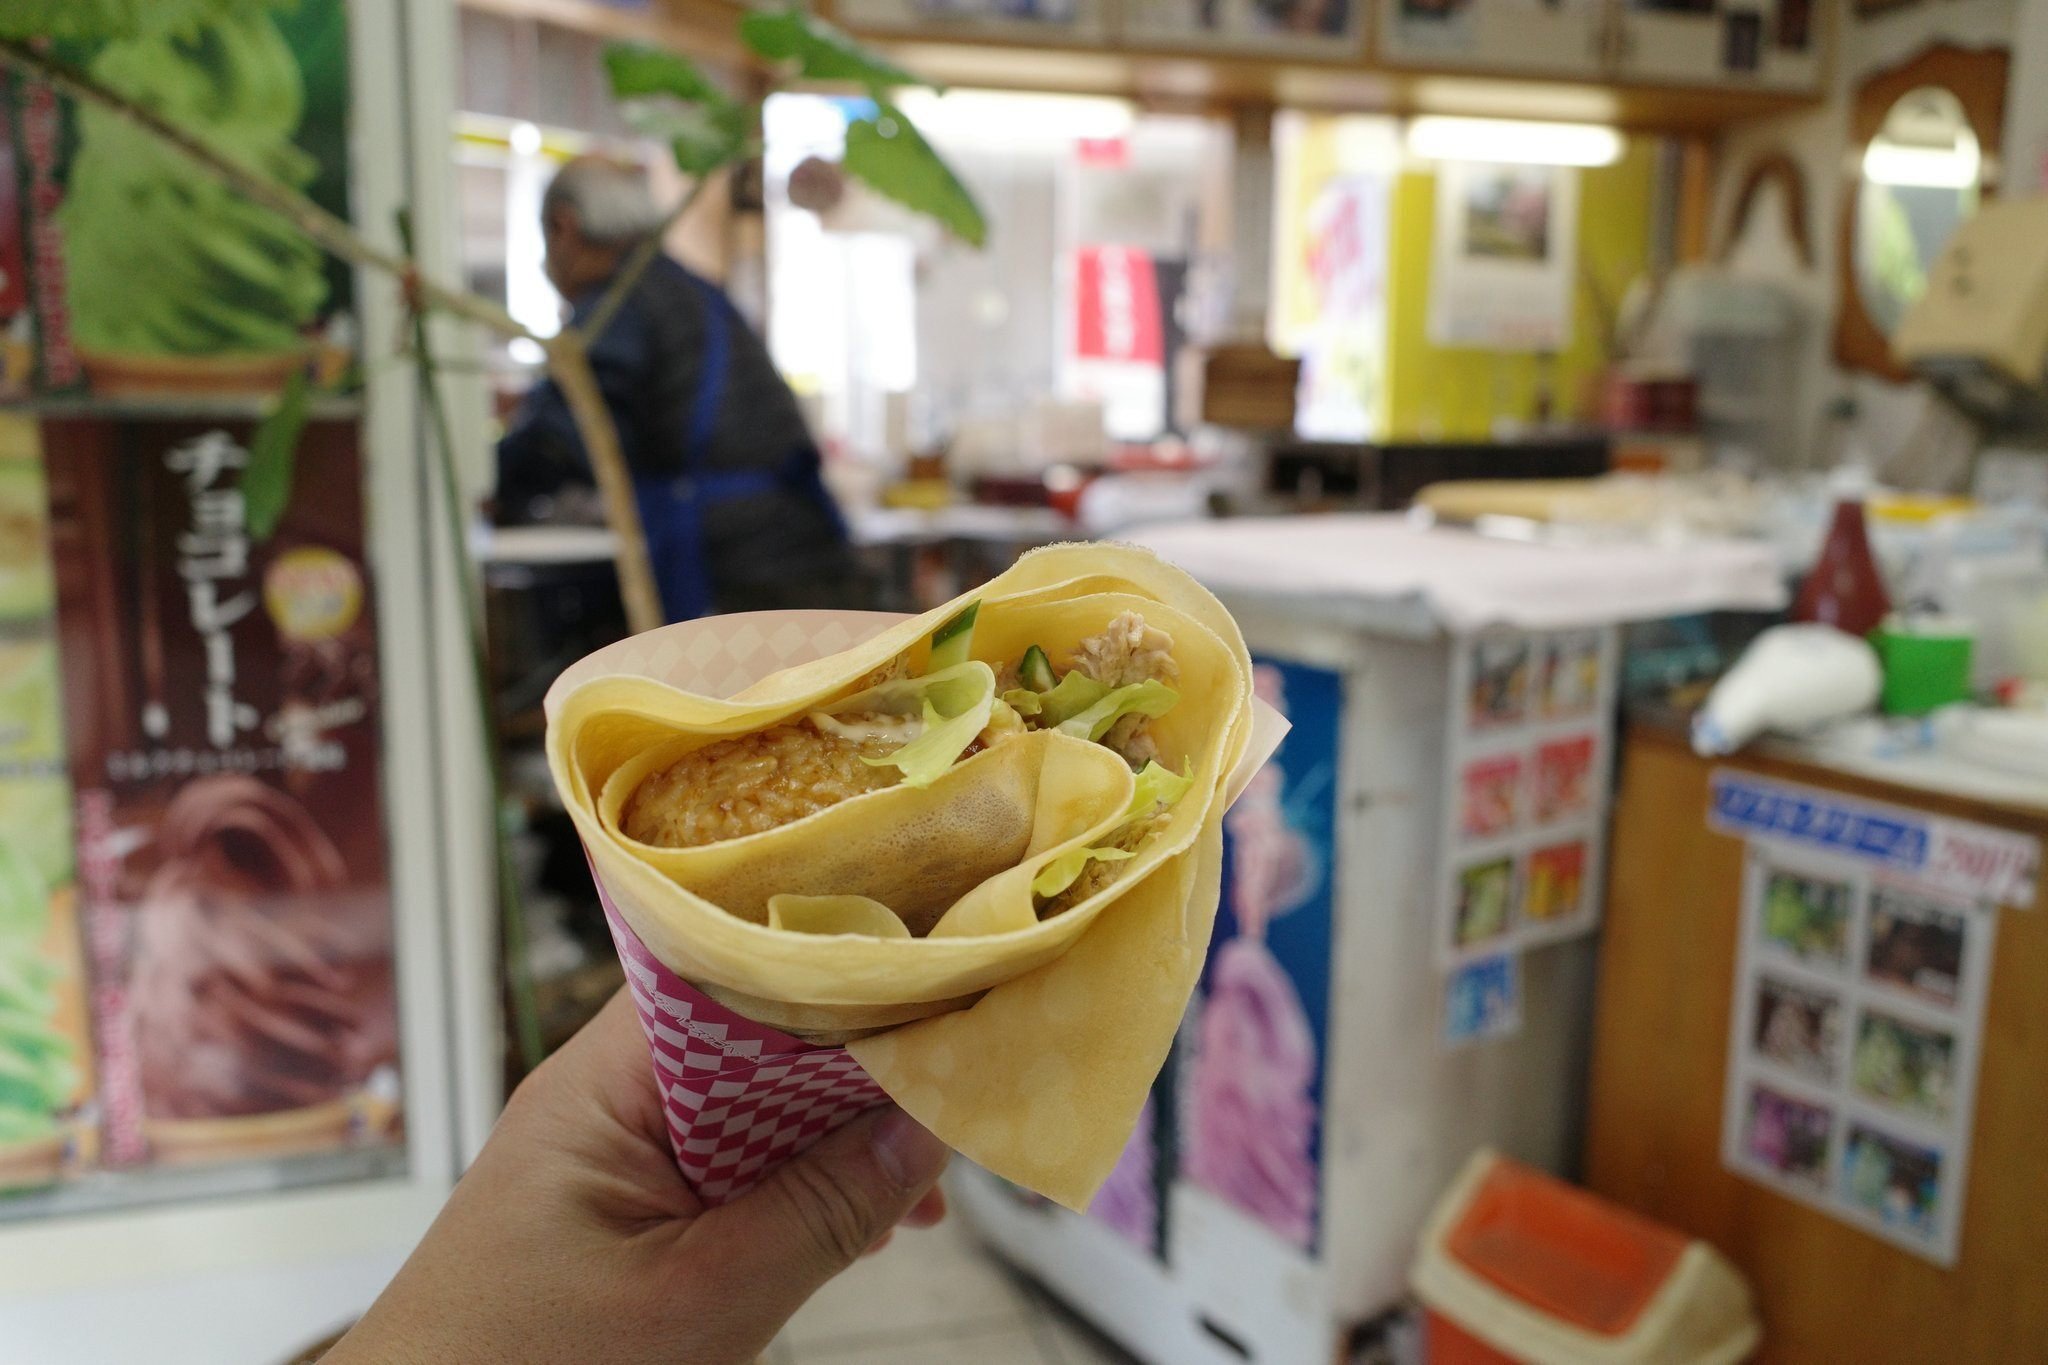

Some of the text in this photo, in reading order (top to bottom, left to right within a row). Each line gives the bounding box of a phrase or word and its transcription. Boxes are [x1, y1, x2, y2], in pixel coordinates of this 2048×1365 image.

[163, 430, 259, 747] チョコレート
